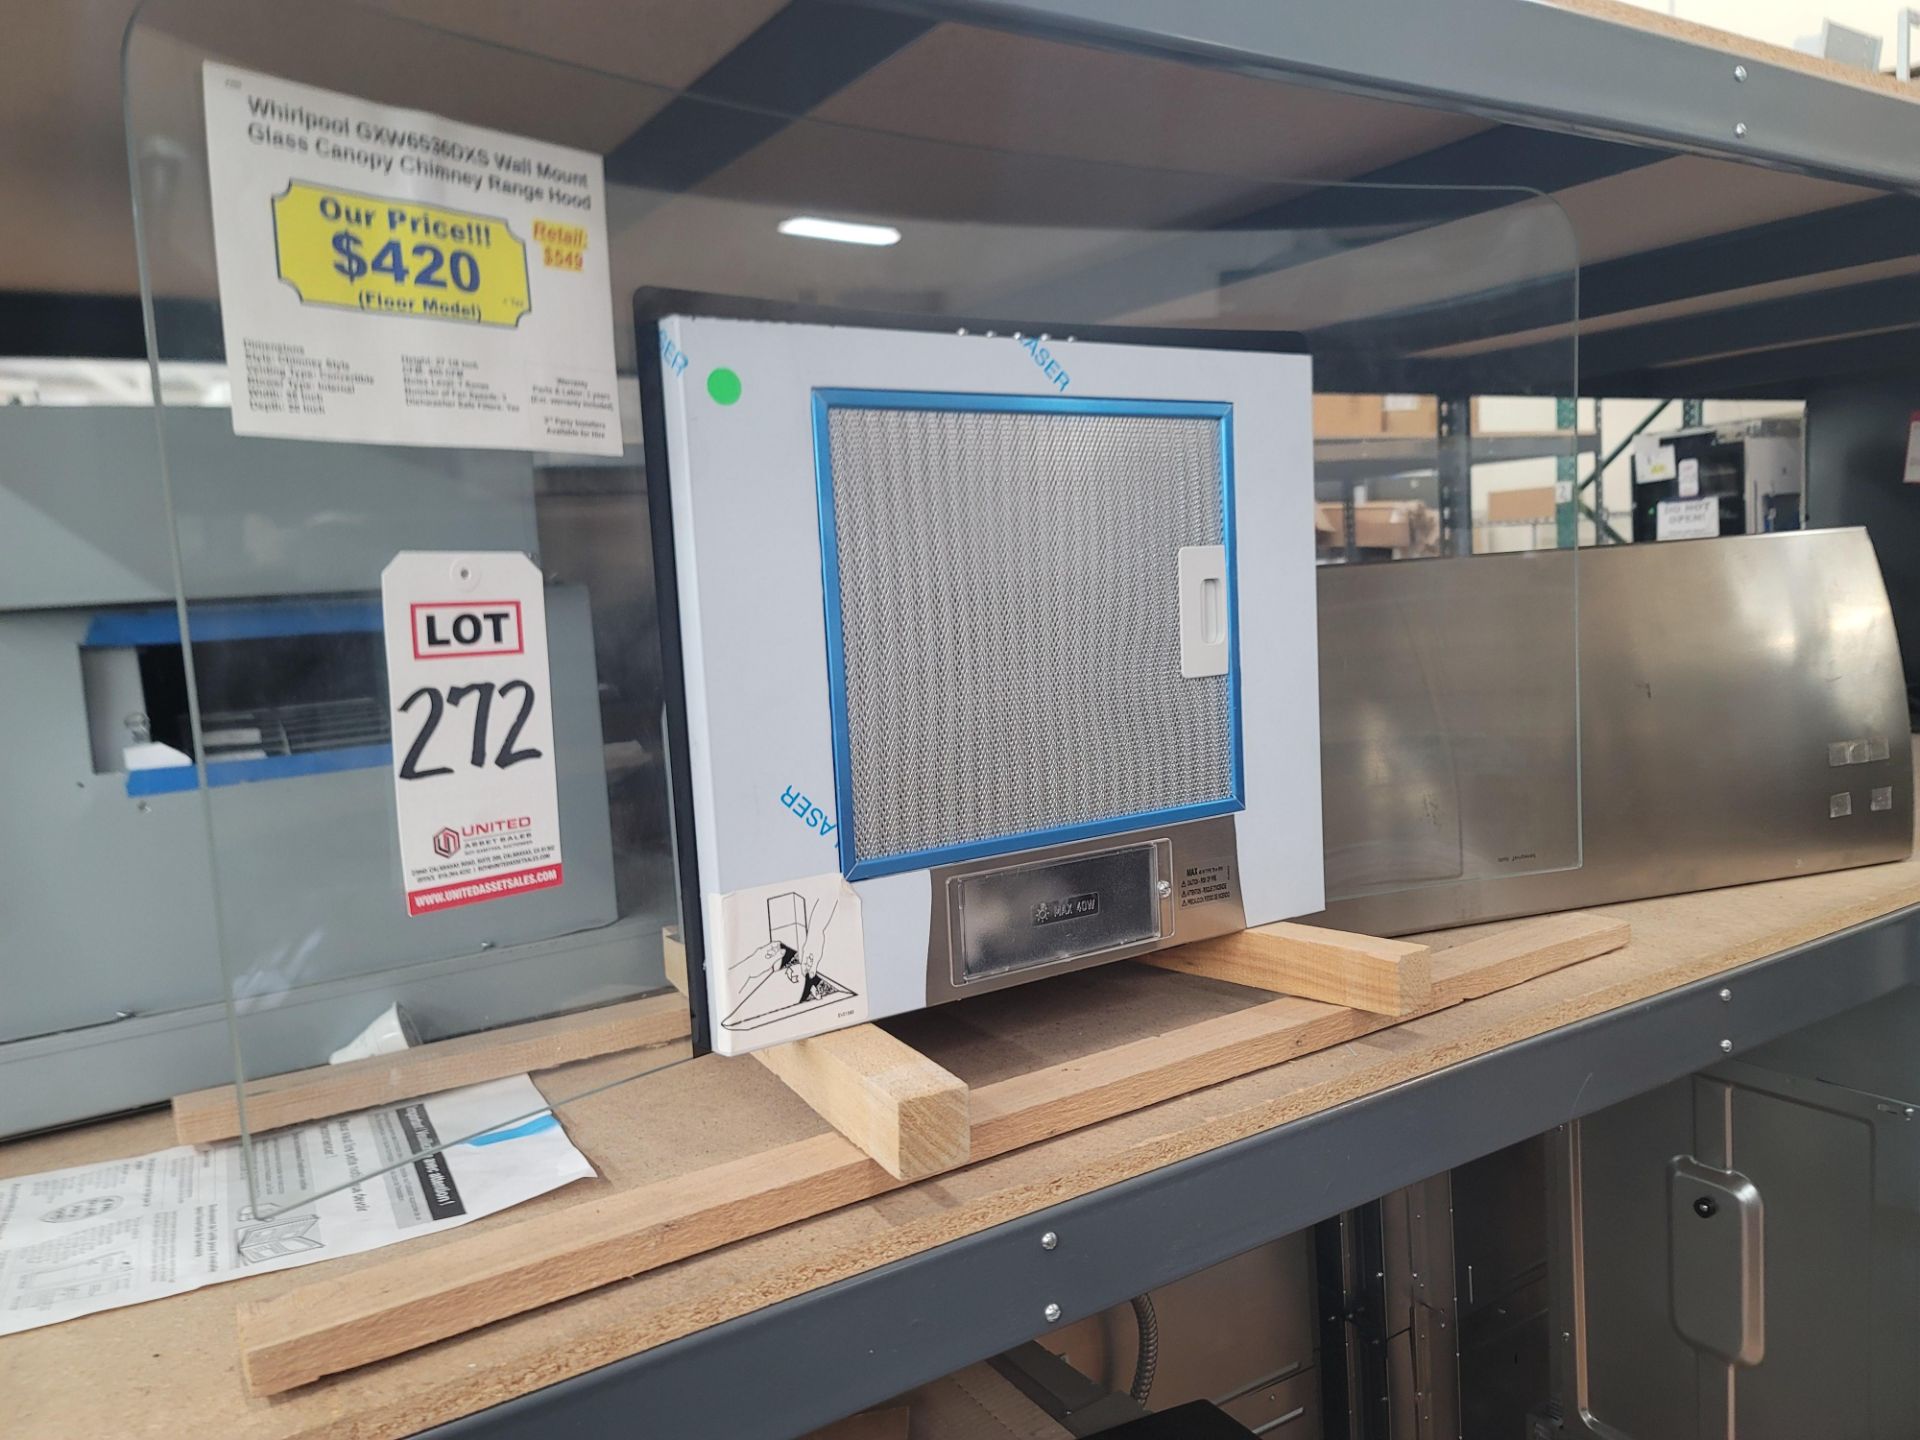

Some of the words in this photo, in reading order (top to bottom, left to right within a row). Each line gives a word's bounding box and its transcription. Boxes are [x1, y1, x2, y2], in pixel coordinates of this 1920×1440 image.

[248, 95, 349, 137] Whirlpool
[494, 152, 532, 177] Wall
[537, 162, 588, 188] Mount
[248, 122, 308, 152] Glass
[316, 137, 393, 175] Canopy
[400, 155, 482, 191] Chimney
[488, 174, 544, 202] Range
[549, 187, 592, 211] Hood
[319, 197, 376, 228] Our
[388, 207, 491, 247] Price!!!
[332, 229, 481, 294] $420
[543, 248, 583, 271] $549
[358, 288, 414, 312] (Floor
[423, 297, 482, 323] Model)
[660, 329, 689, 377] ER
[1022, 336, 1070, 392] ASER
[425, 613, 510, 646] LOT
[398, 680, 543, 780] 272
[461, 816, 532, 837] UNITED
[780, 785, 838, 848] ASER
[415, 869, 558, 908] WWW.UNITEDASSETSALES.COM
[1054, 903, 1073, 917] MAX
[1076, 898, 1096, 913] 40W
[429, 1172, 451, 1202] attention
